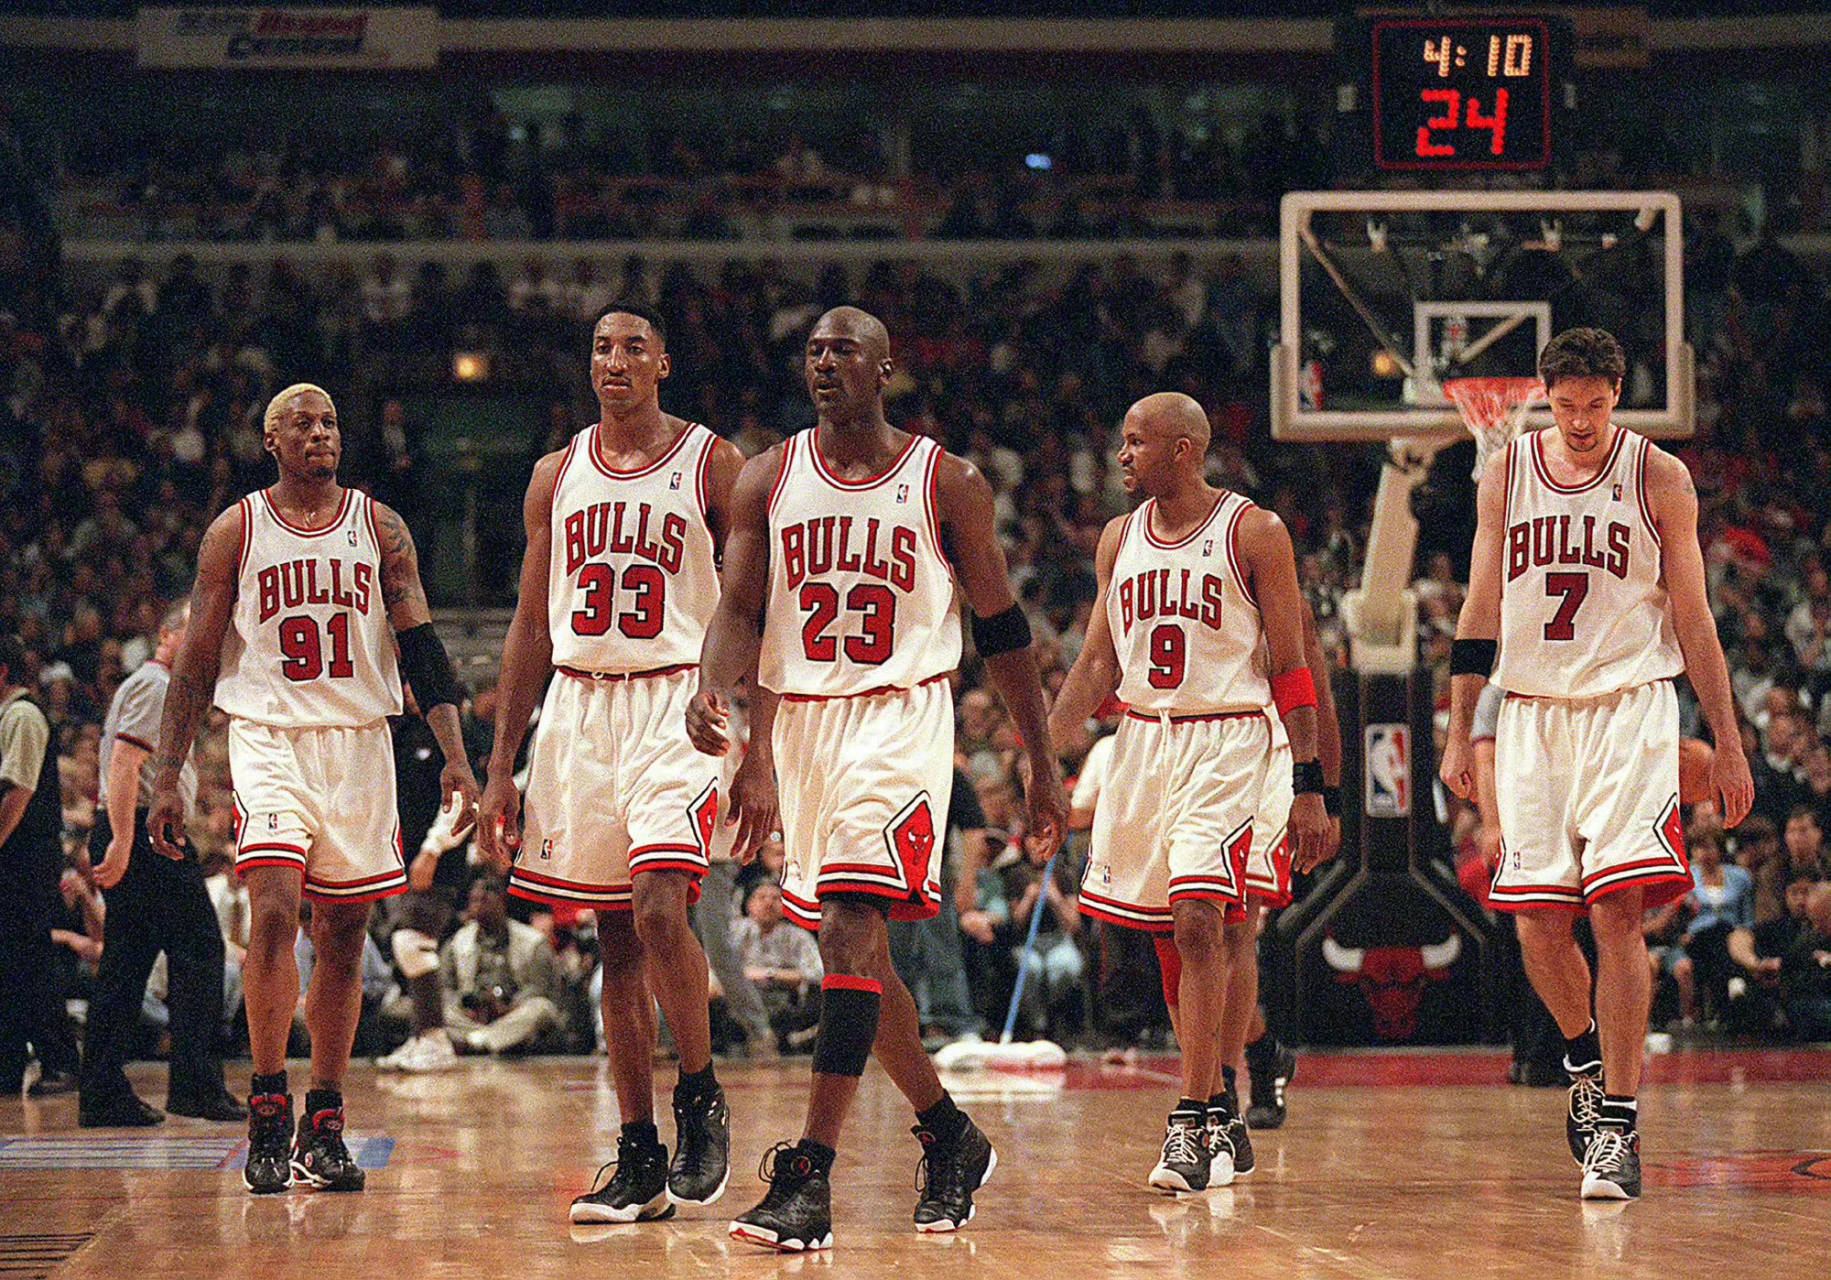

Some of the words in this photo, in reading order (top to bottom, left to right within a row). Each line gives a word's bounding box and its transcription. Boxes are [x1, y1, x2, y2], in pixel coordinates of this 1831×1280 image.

[1423, 34, 1533, 77] 4:10
[1416, 88, 1509, 157] 24
[565, 502, 687, 577] BULLS
[781, 516, 916, 593] BULLS
[1508, 515, 1630, 582] BULLS
[258, 558, 372, 625] BULLS
[571, 562, 665, 639] 33
[800, 582, 896, 665] 23
[1119, 569, 1222, 638] BULLS
[1544, 572, 1589, 640] 7
[279, 612, 354, 681] 91
[1148, 624, 1185, 689] 9
